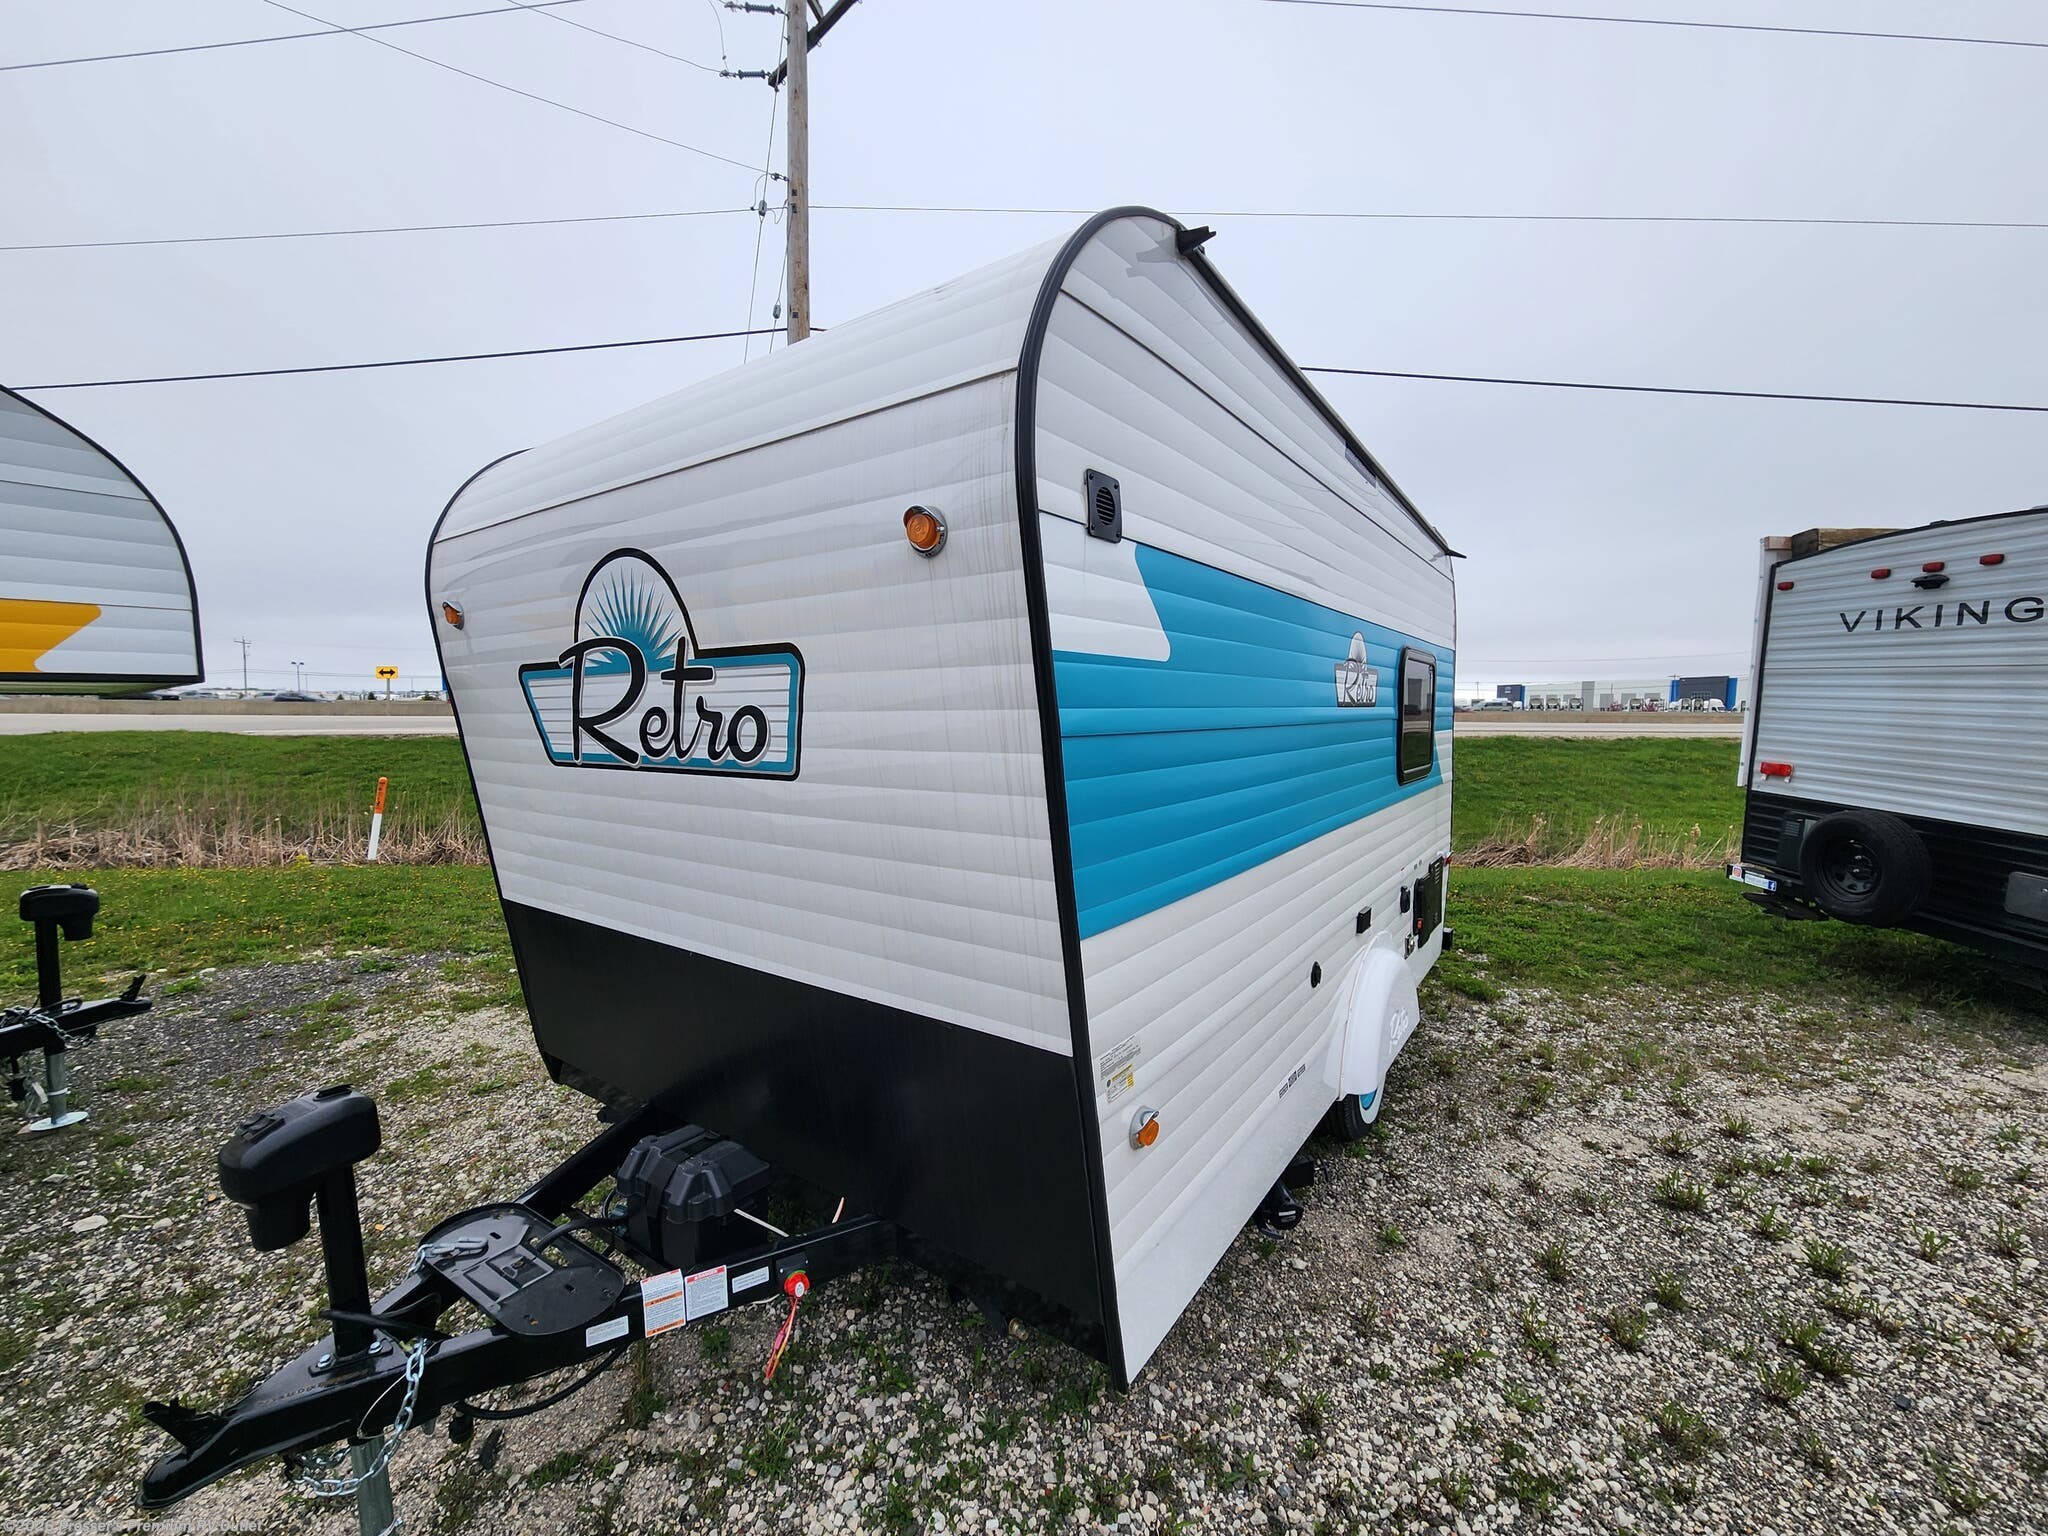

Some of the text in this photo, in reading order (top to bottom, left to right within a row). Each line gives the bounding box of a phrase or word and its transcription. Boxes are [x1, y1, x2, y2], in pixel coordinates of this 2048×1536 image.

[1839, 597, 2045, 633] VIKING
[558, 636, 768, 765] Retro
[1343, 658, 1374, 704] Retro
